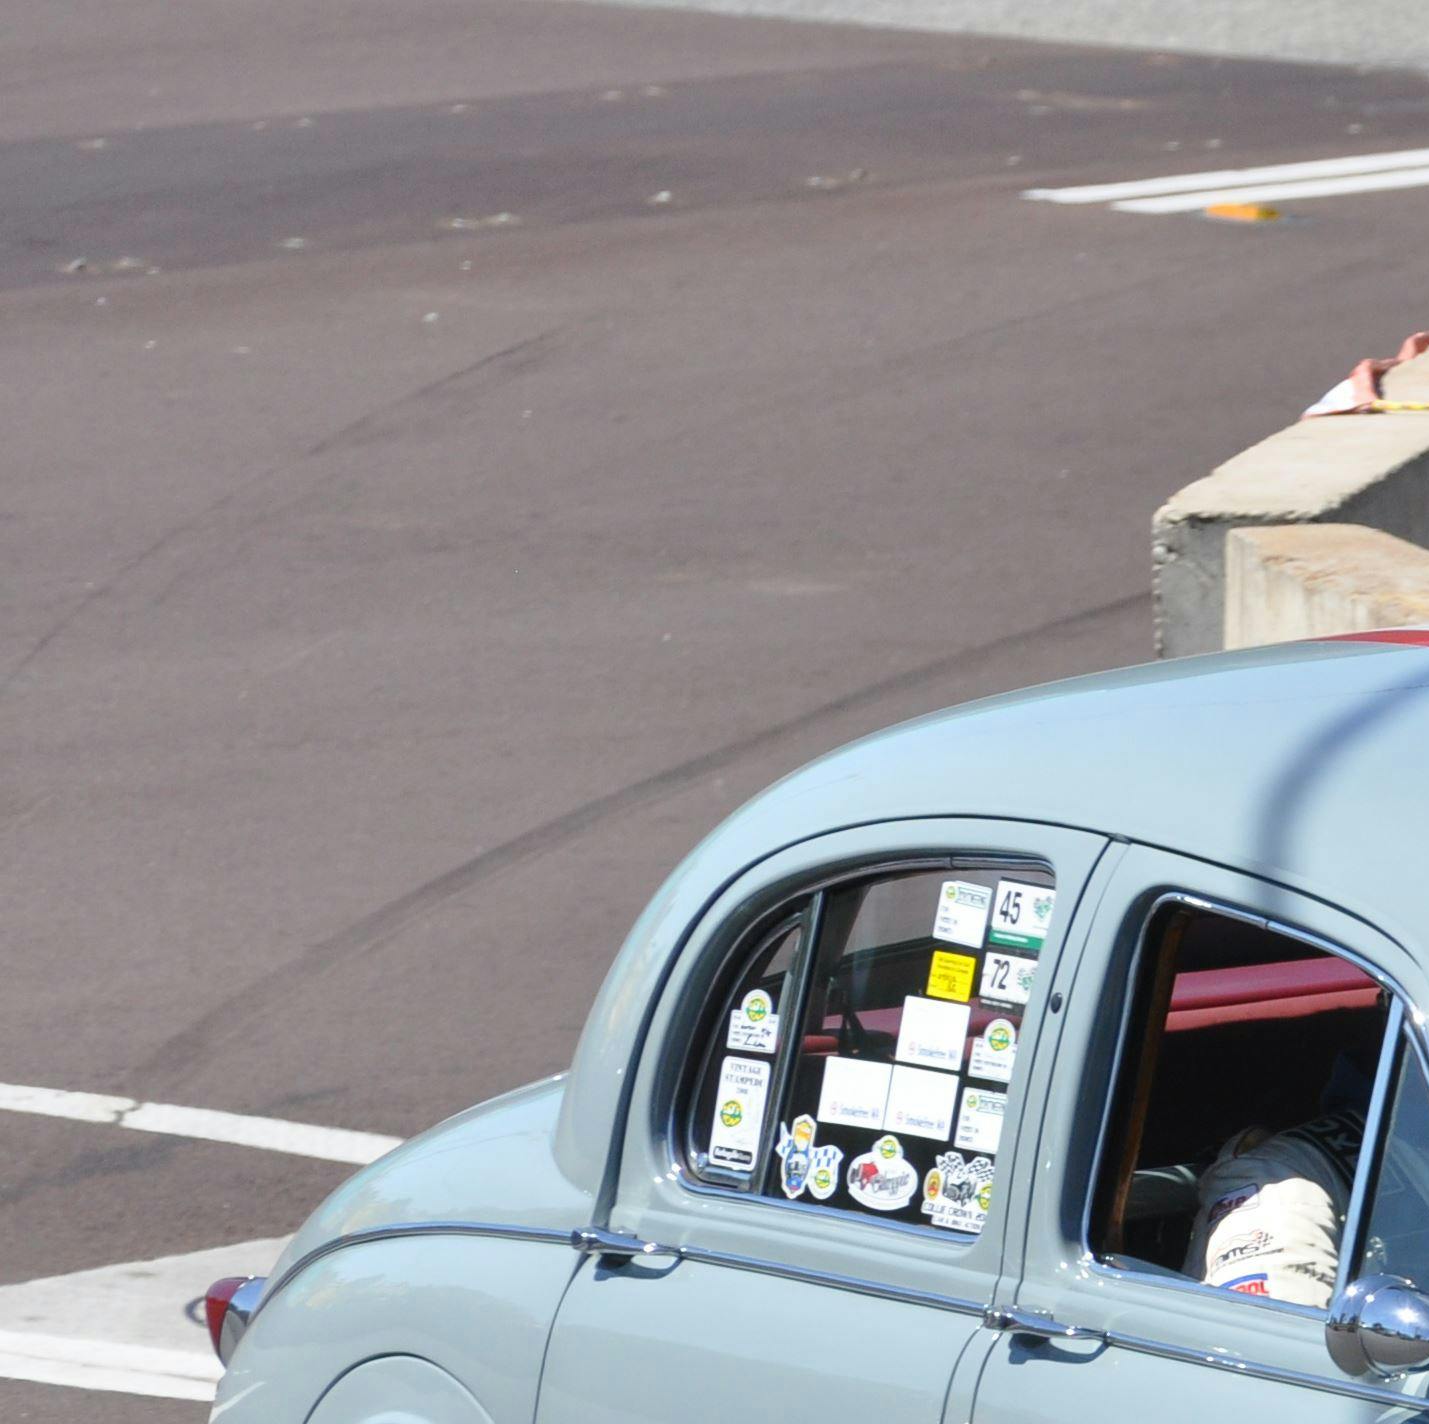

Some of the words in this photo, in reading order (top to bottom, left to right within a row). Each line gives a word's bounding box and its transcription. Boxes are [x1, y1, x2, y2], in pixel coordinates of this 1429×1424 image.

[999, 890, 1022, 925] 45
[990, 958, 1010, 990] 72
[730, 1063, 762, 1075] VINTAGE
